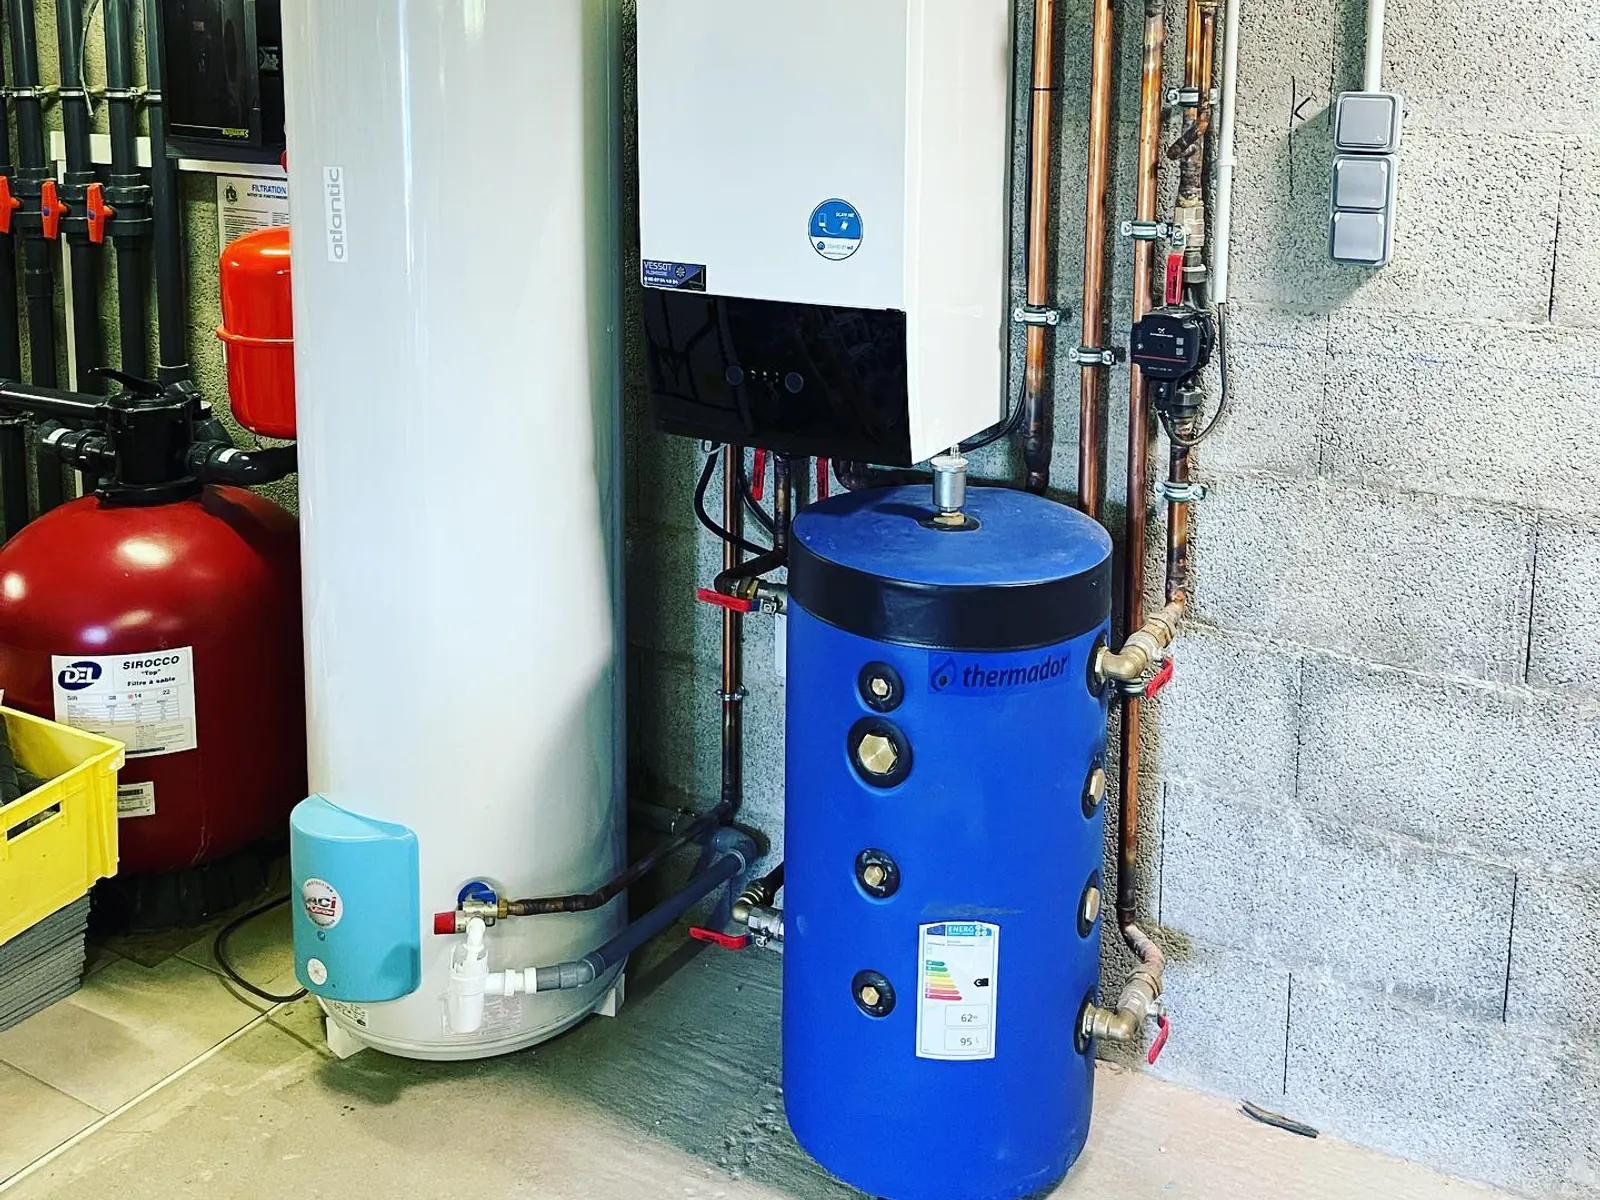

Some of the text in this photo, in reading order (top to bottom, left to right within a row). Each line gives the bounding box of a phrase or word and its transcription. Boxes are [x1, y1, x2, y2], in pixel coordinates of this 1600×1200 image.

[252, 184, 287, 195] FILTRATION
[327, 168, 344, 260] atlantic
[643, 261, 672, 271] VESSOT
[122, 655, 180, 670] SIROCCO
[62, 667, 94, 684] DEL
[962, 654, 1068, 688] thermador
[156, 676, 176, 684] sable
[947, 925, 974, 933] ENERG
[960, 1013, 973, 1022] 62
[960, 1037, 972, 1046] 95
